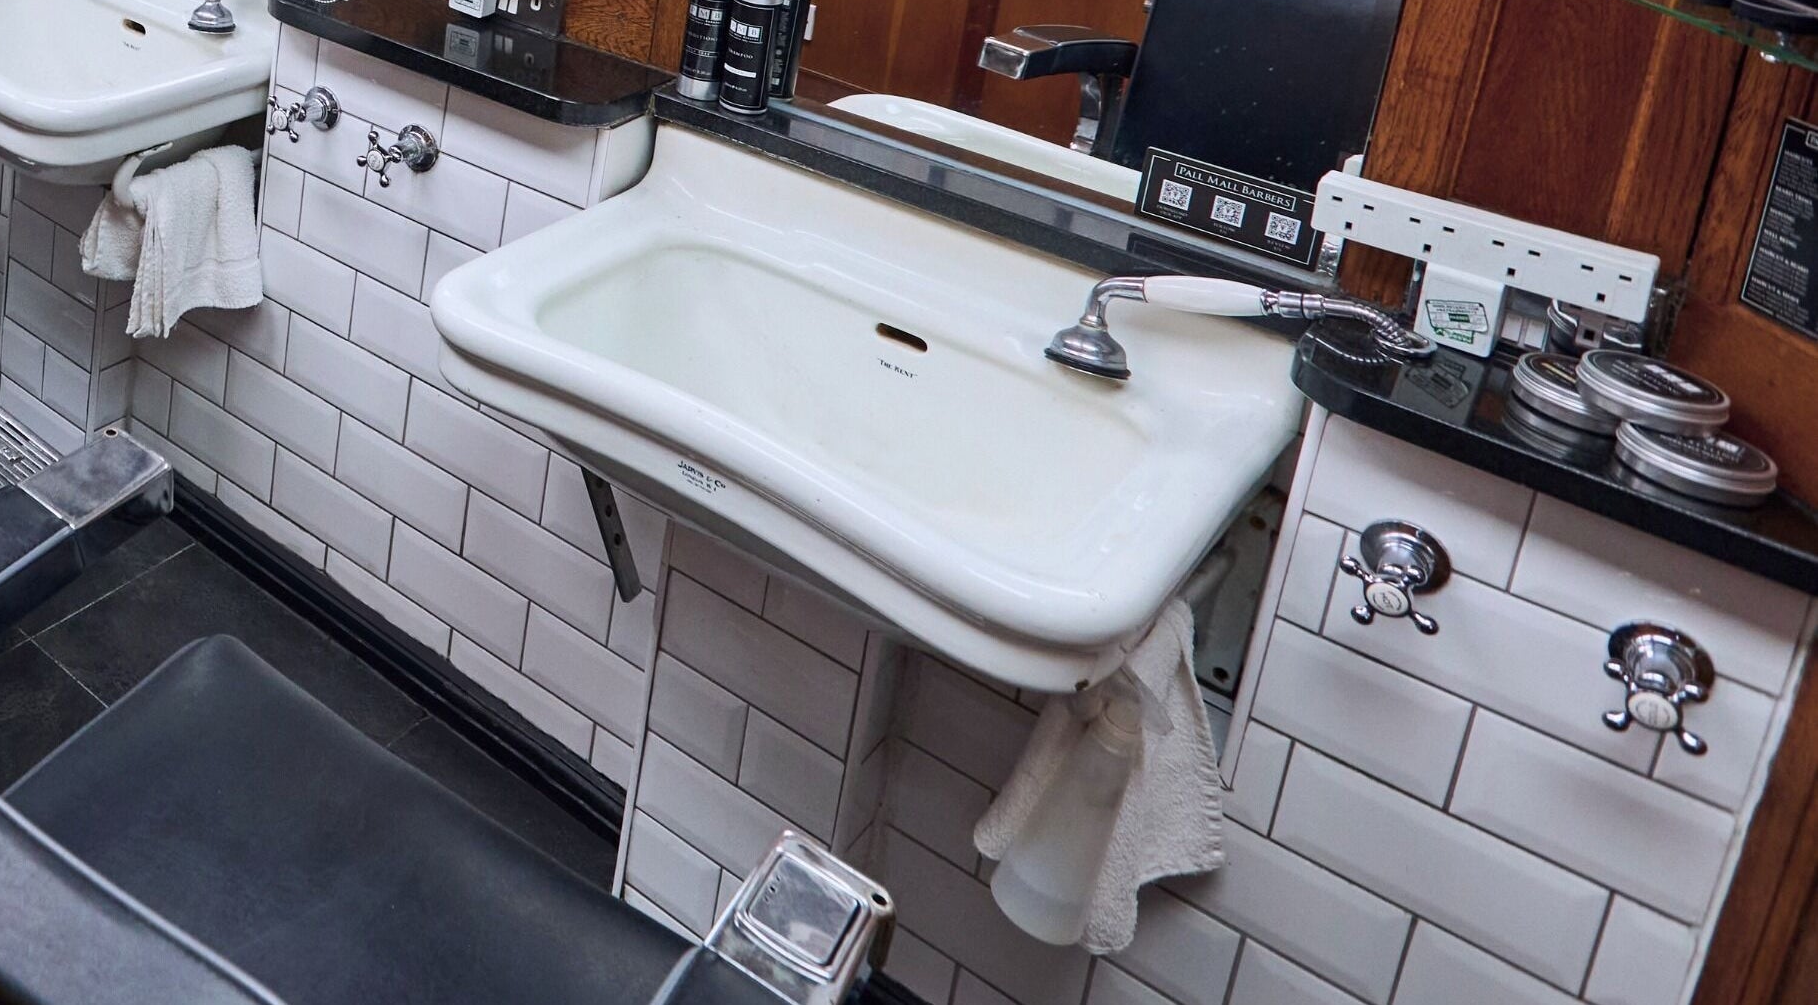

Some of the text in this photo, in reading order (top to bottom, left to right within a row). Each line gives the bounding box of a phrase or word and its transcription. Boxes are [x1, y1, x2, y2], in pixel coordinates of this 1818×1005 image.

[1178, 166, 1292, 208] PALL MALL BARBERS
